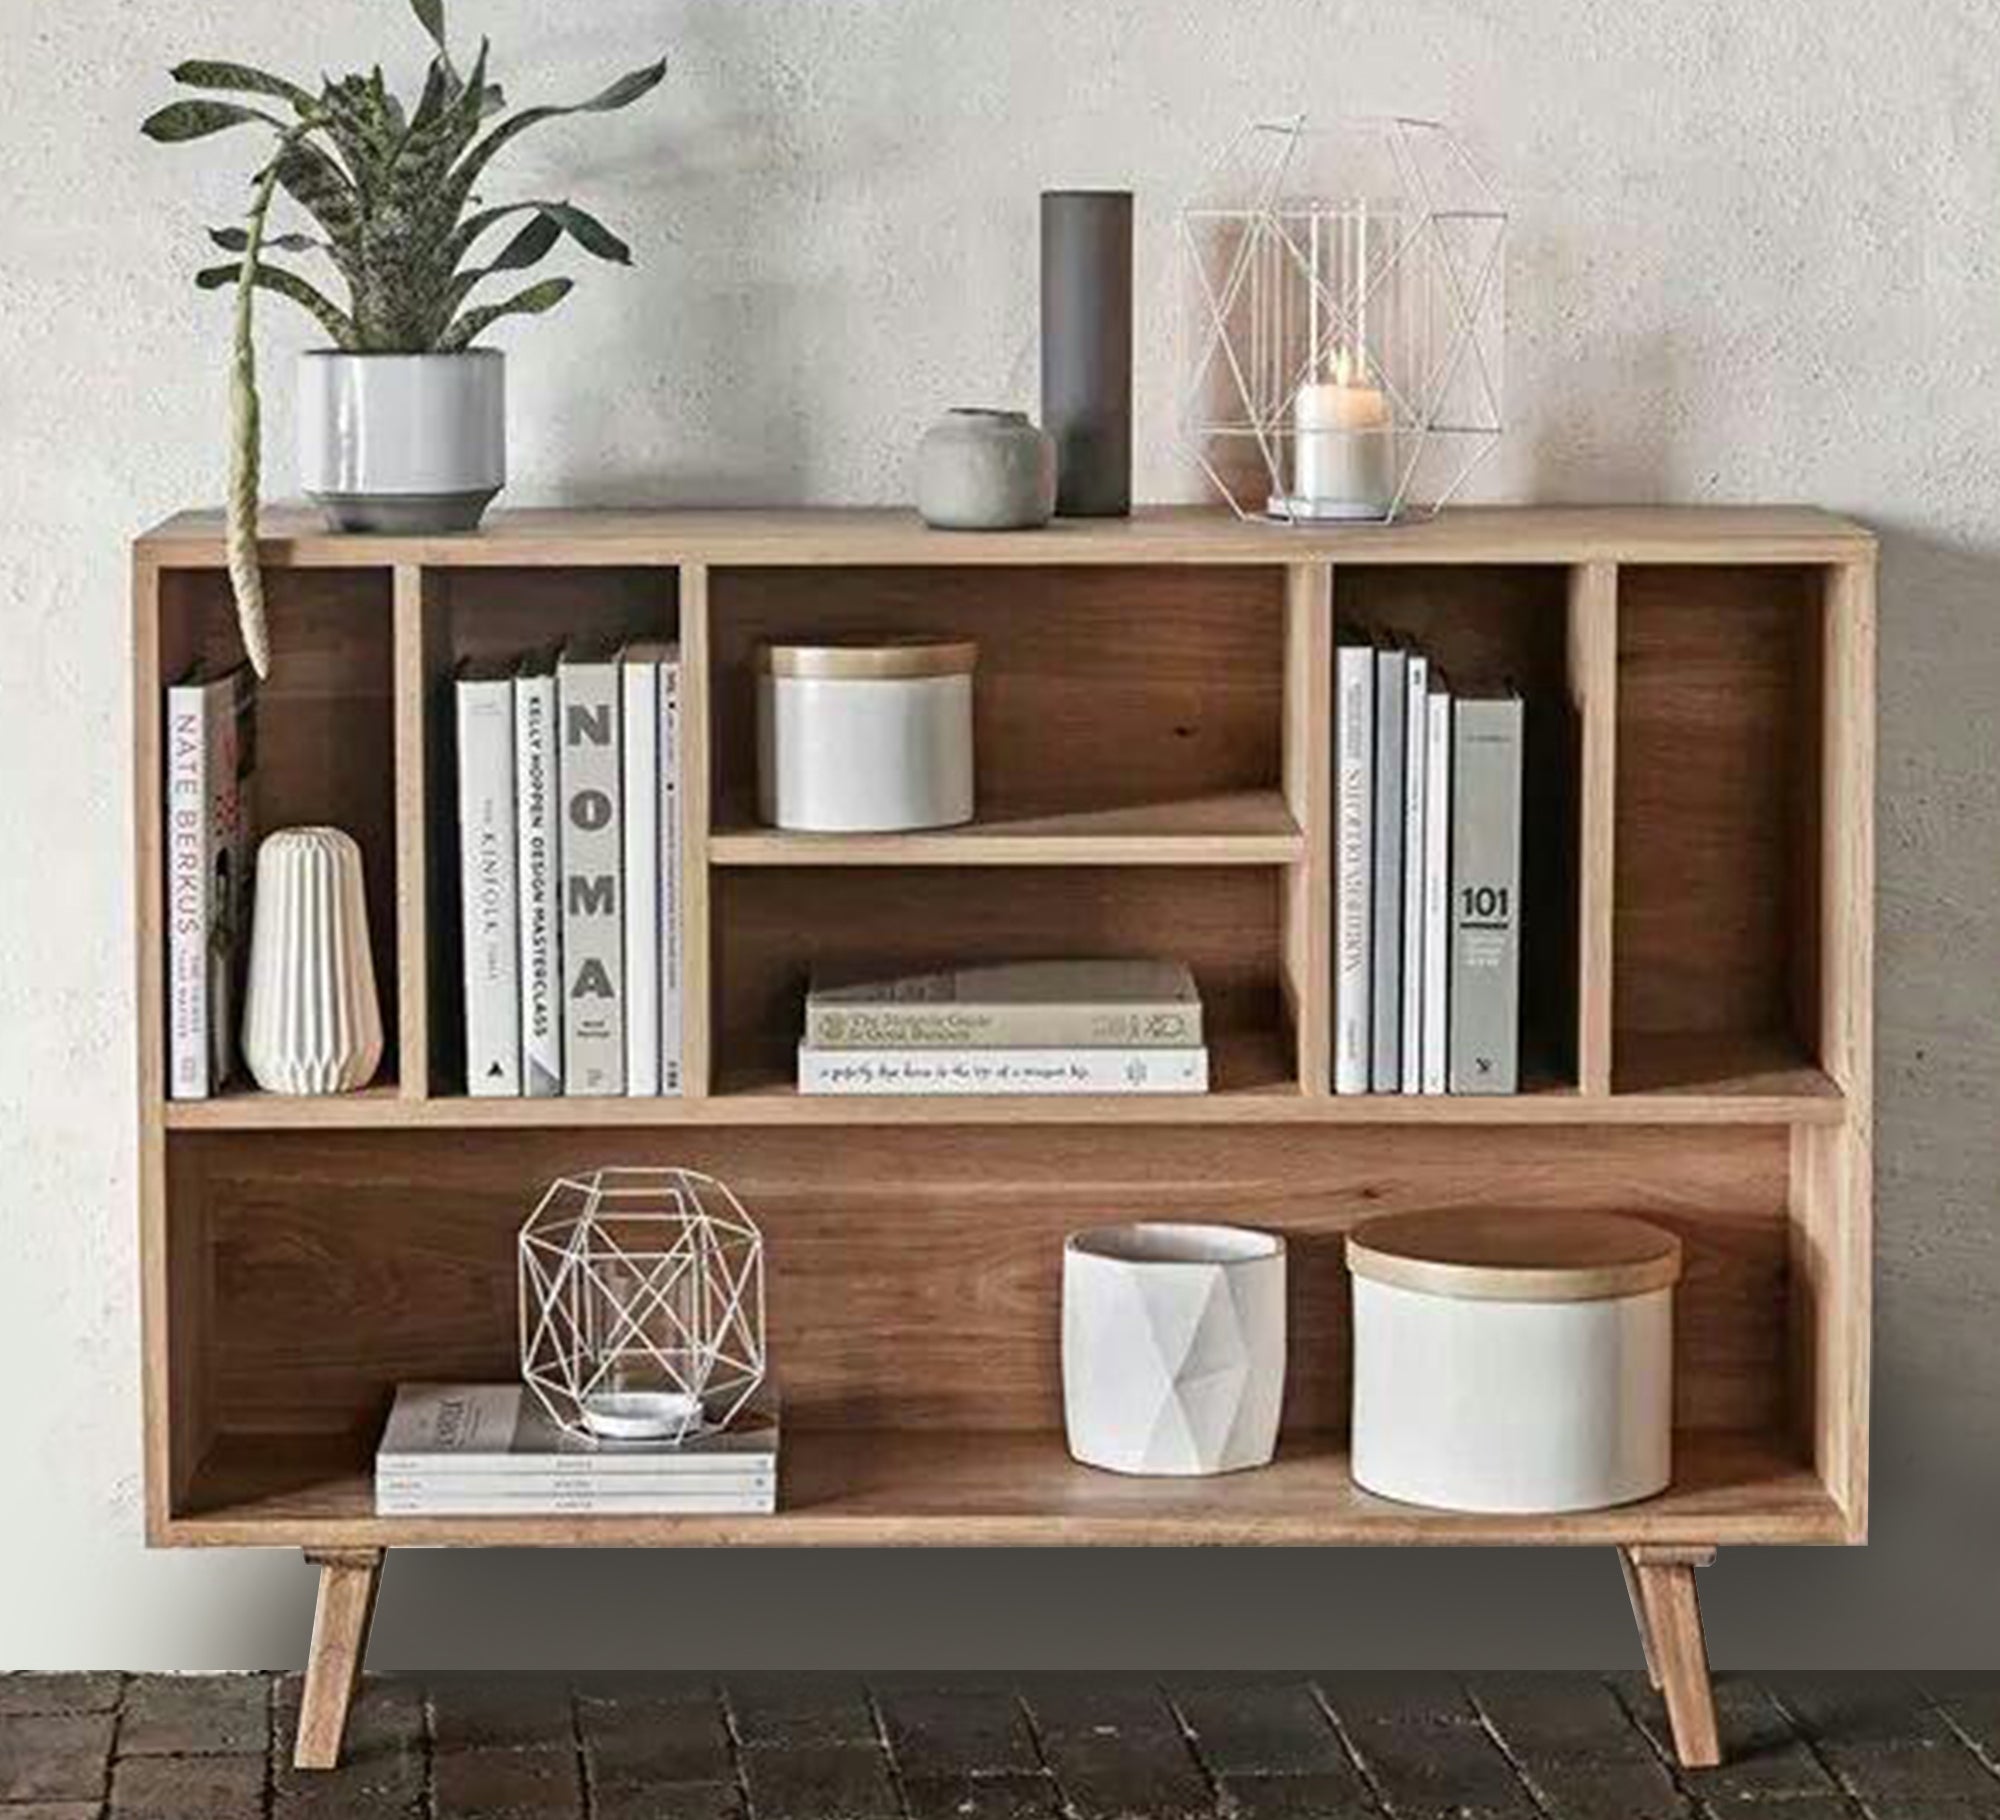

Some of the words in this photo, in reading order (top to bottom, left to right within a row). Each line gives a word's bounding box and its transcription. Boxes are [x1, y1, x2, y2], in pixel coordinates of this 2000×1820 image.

[175, 713, 198, 795] NATE
[529, 696, 541, 749] KELLY
[530, 753, 544, 829] HOPPEN
[175, 808, 199, 936] BERKUS
[480, 832, 499, 935] KINFOLK
[531, 836, 545, 902] DESIGN
[1461, 886, 1508, 918] 101
[532, 906, 549, 1038] MASTERCLASS
